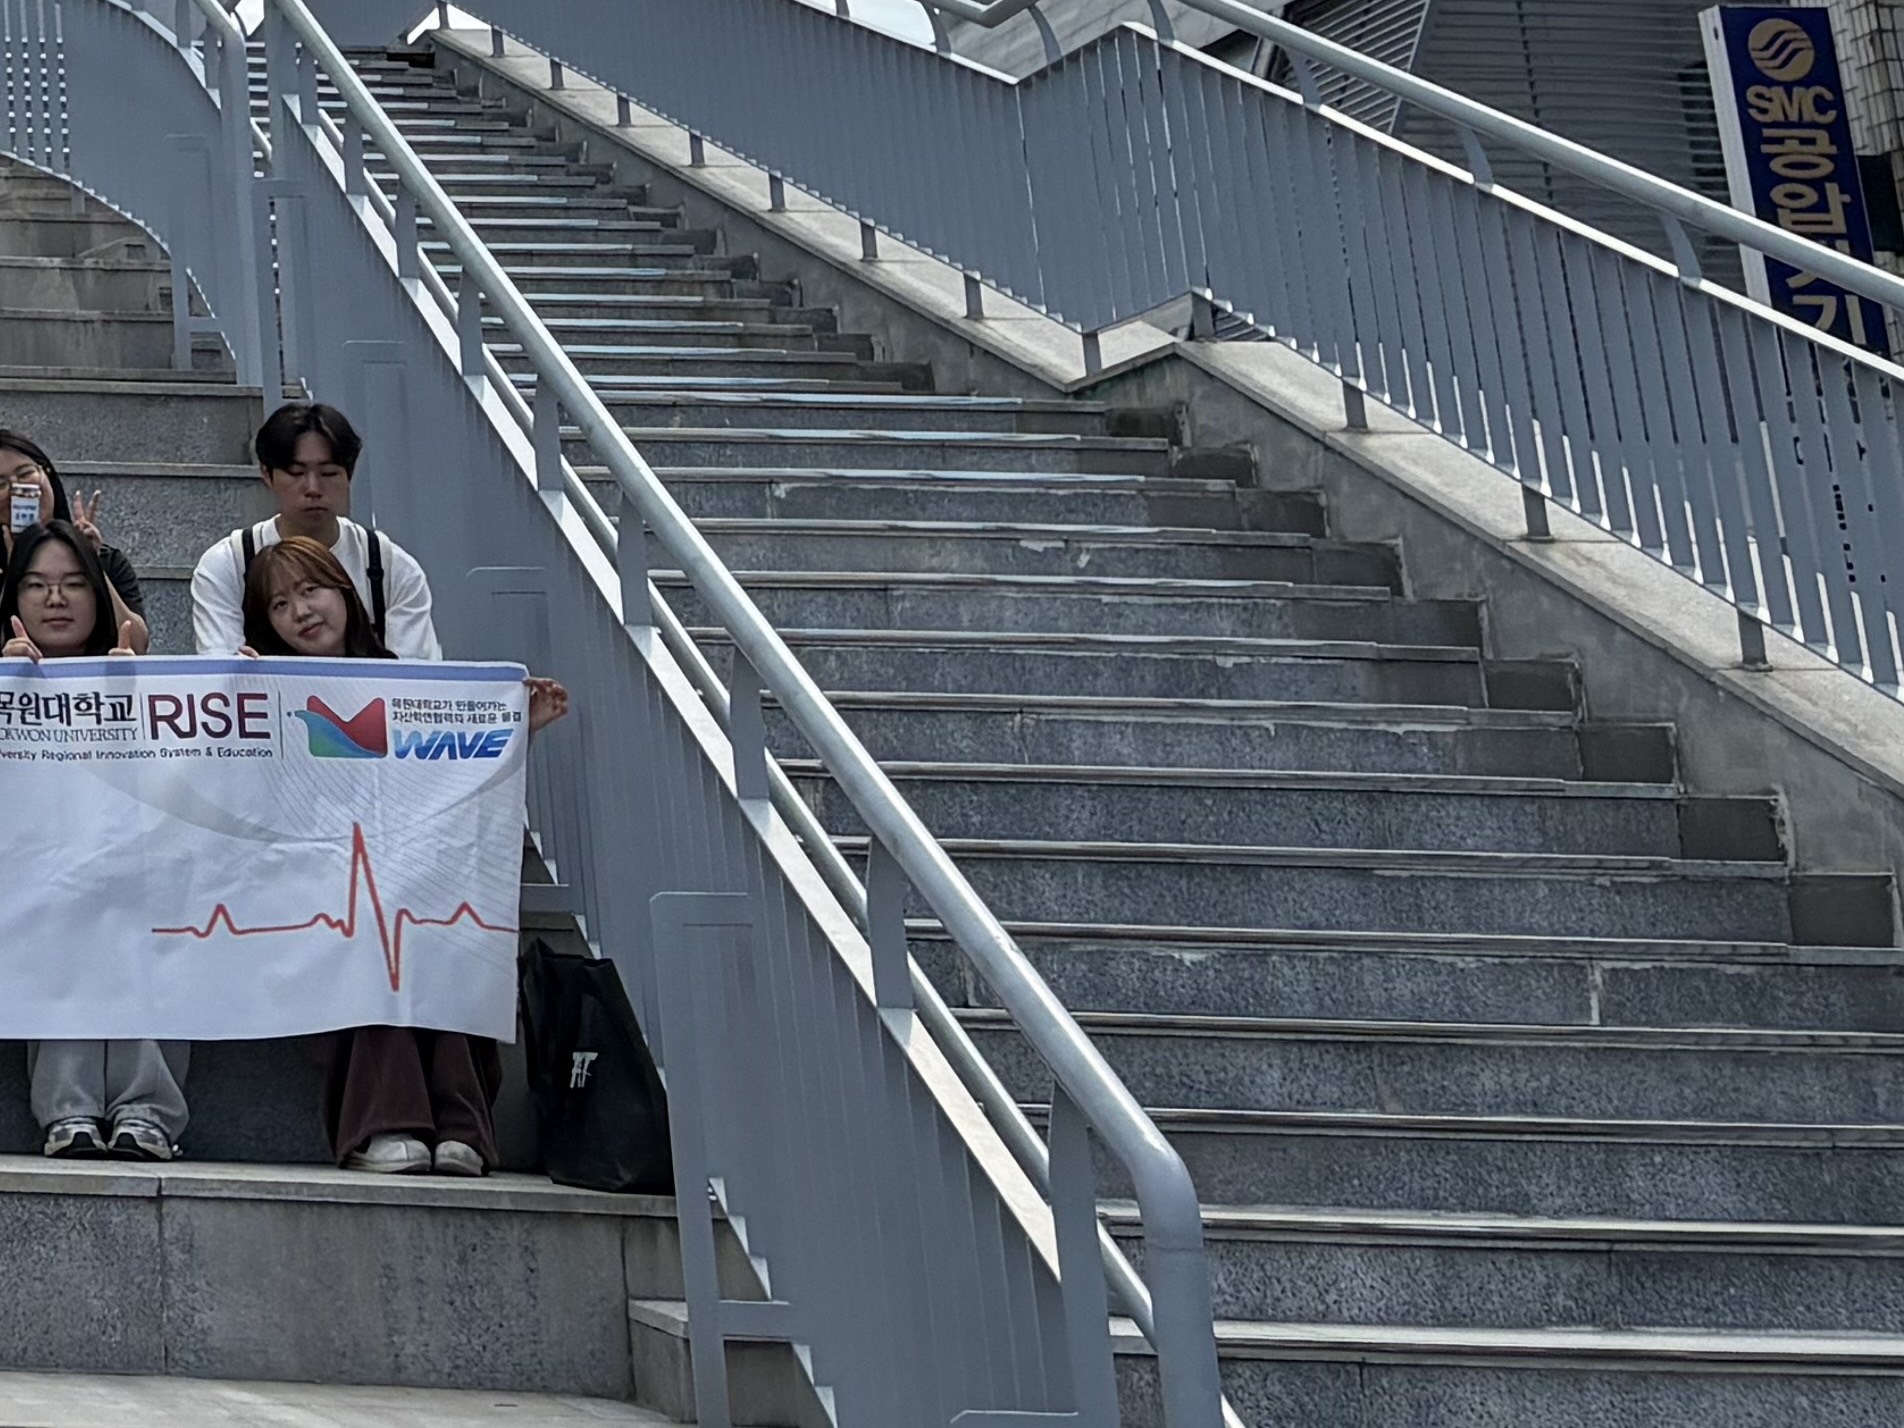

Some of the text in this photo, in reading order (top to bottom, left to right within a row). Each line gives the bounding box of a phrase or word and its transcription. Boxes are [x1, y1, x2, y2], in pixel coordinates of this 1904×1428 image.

[1746, 84, 1837, 124] SMC
[147, 692, 272, 741] RISE
[54, 727, 138, 743] UNIVERSITY
[218, 746, 273, 758] Education
[391, 727, 514, 761] WAVE
